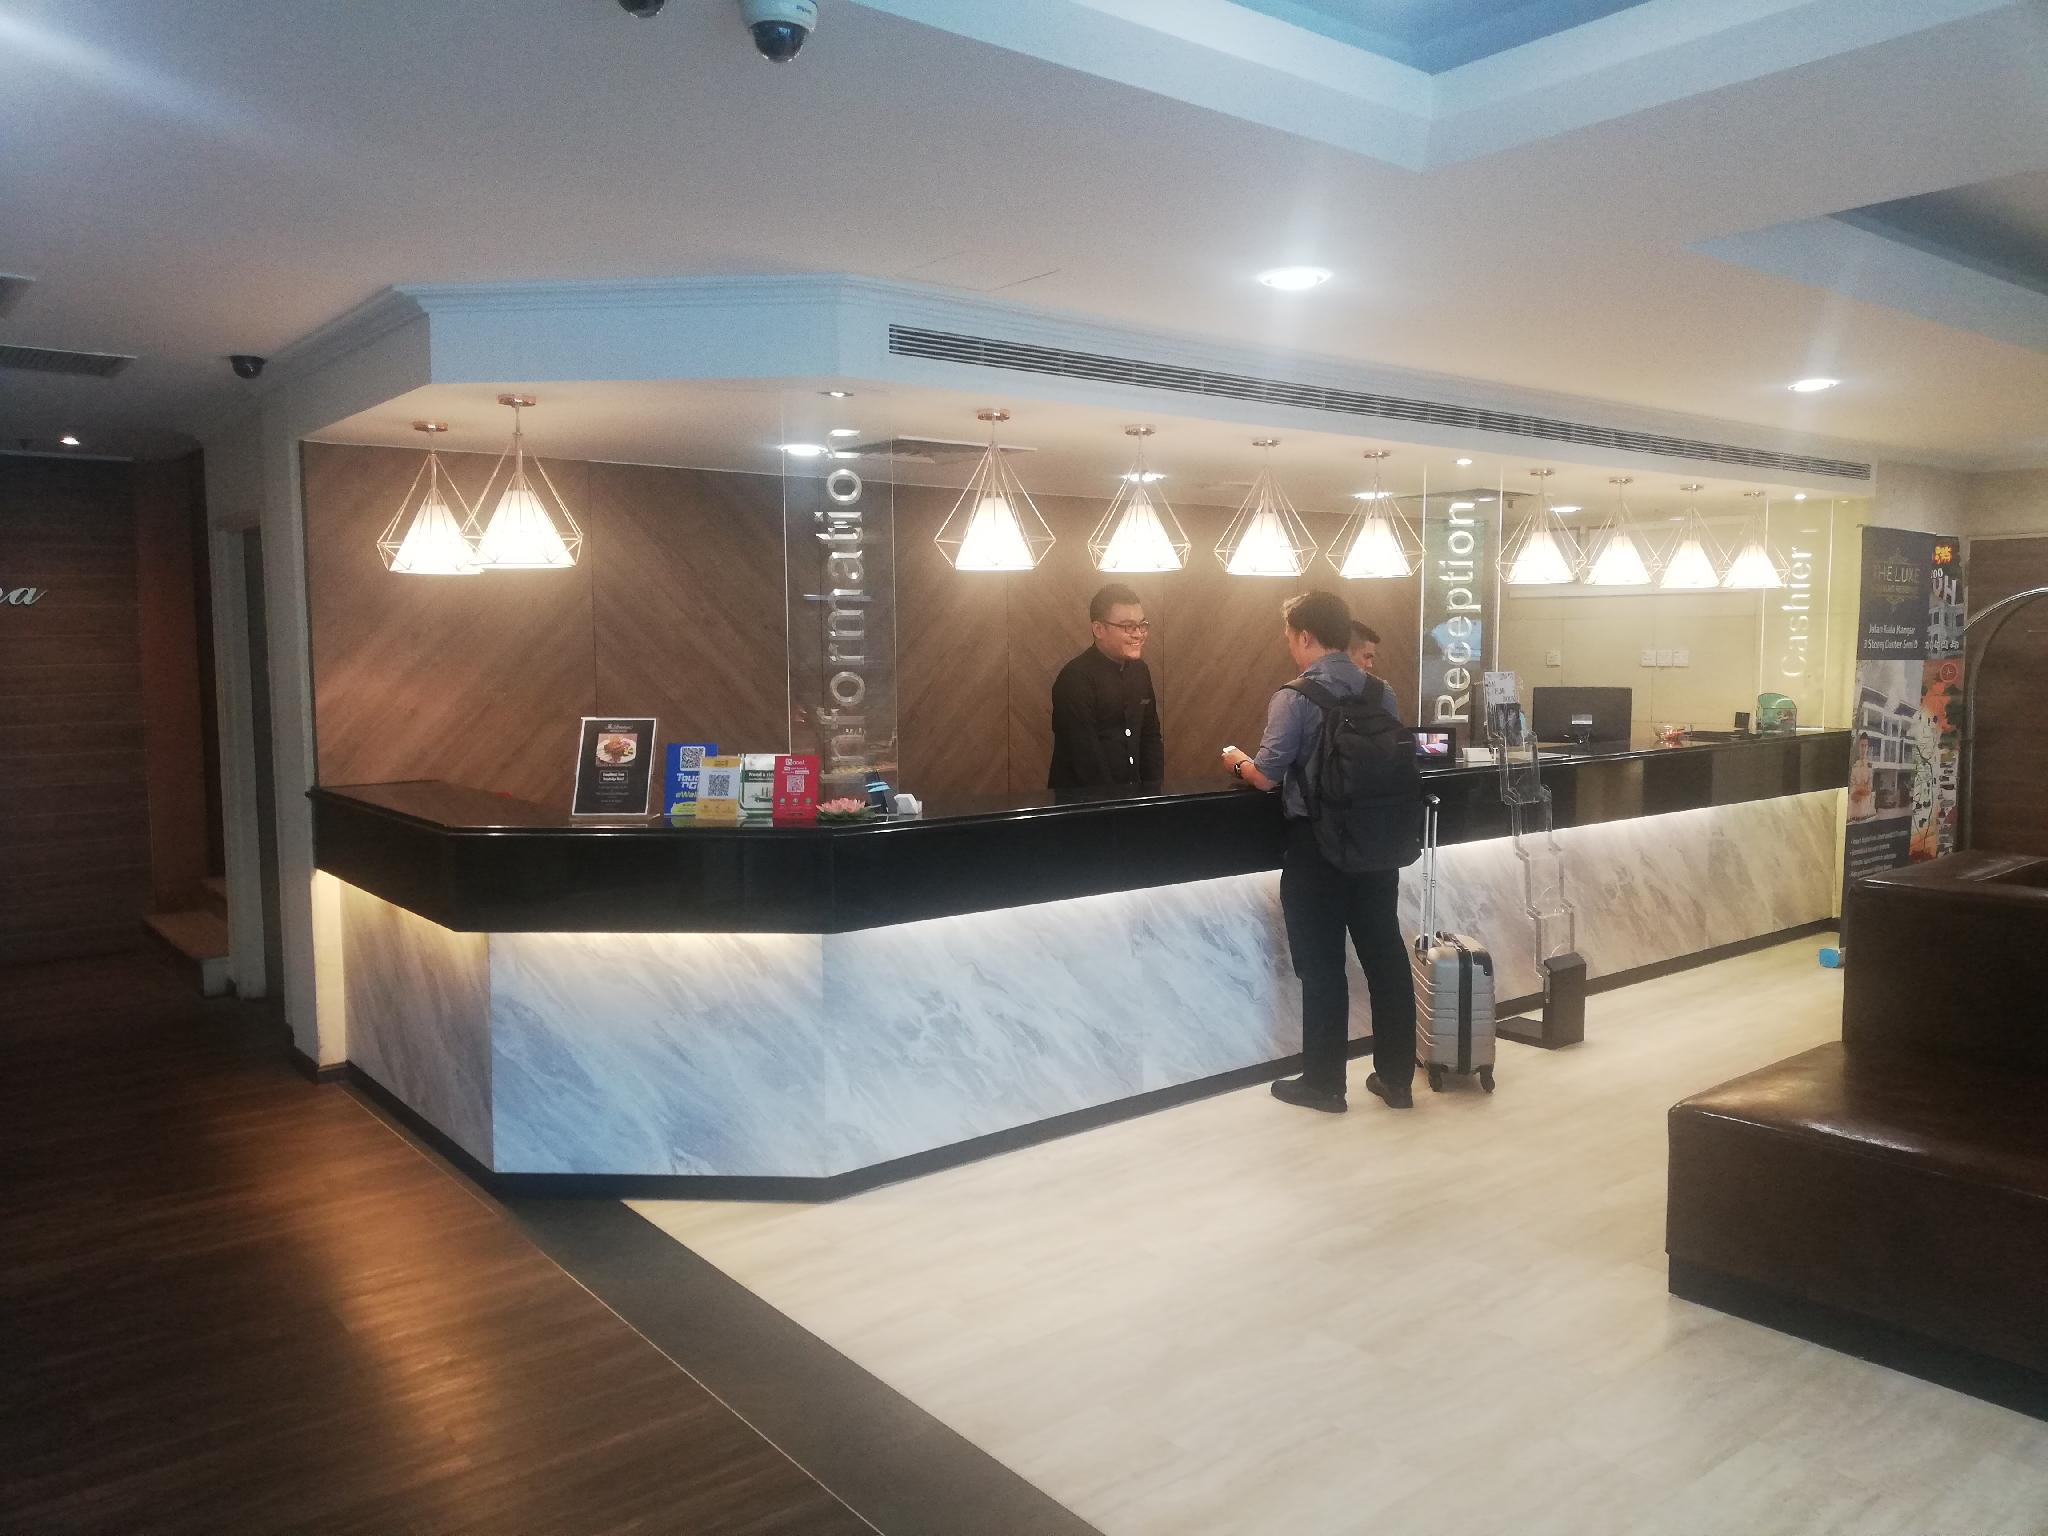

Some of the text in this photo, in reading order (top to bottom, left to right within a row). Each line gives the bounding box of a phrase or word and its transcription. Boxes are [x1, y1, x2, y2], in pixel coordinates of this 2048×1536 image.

[816, 428, 866, 783] Information
[1434, 502, 1482, 724] Reception
[1780, 545, 1813, 677] Cashier
[677, 772, 700, 782] Touc
